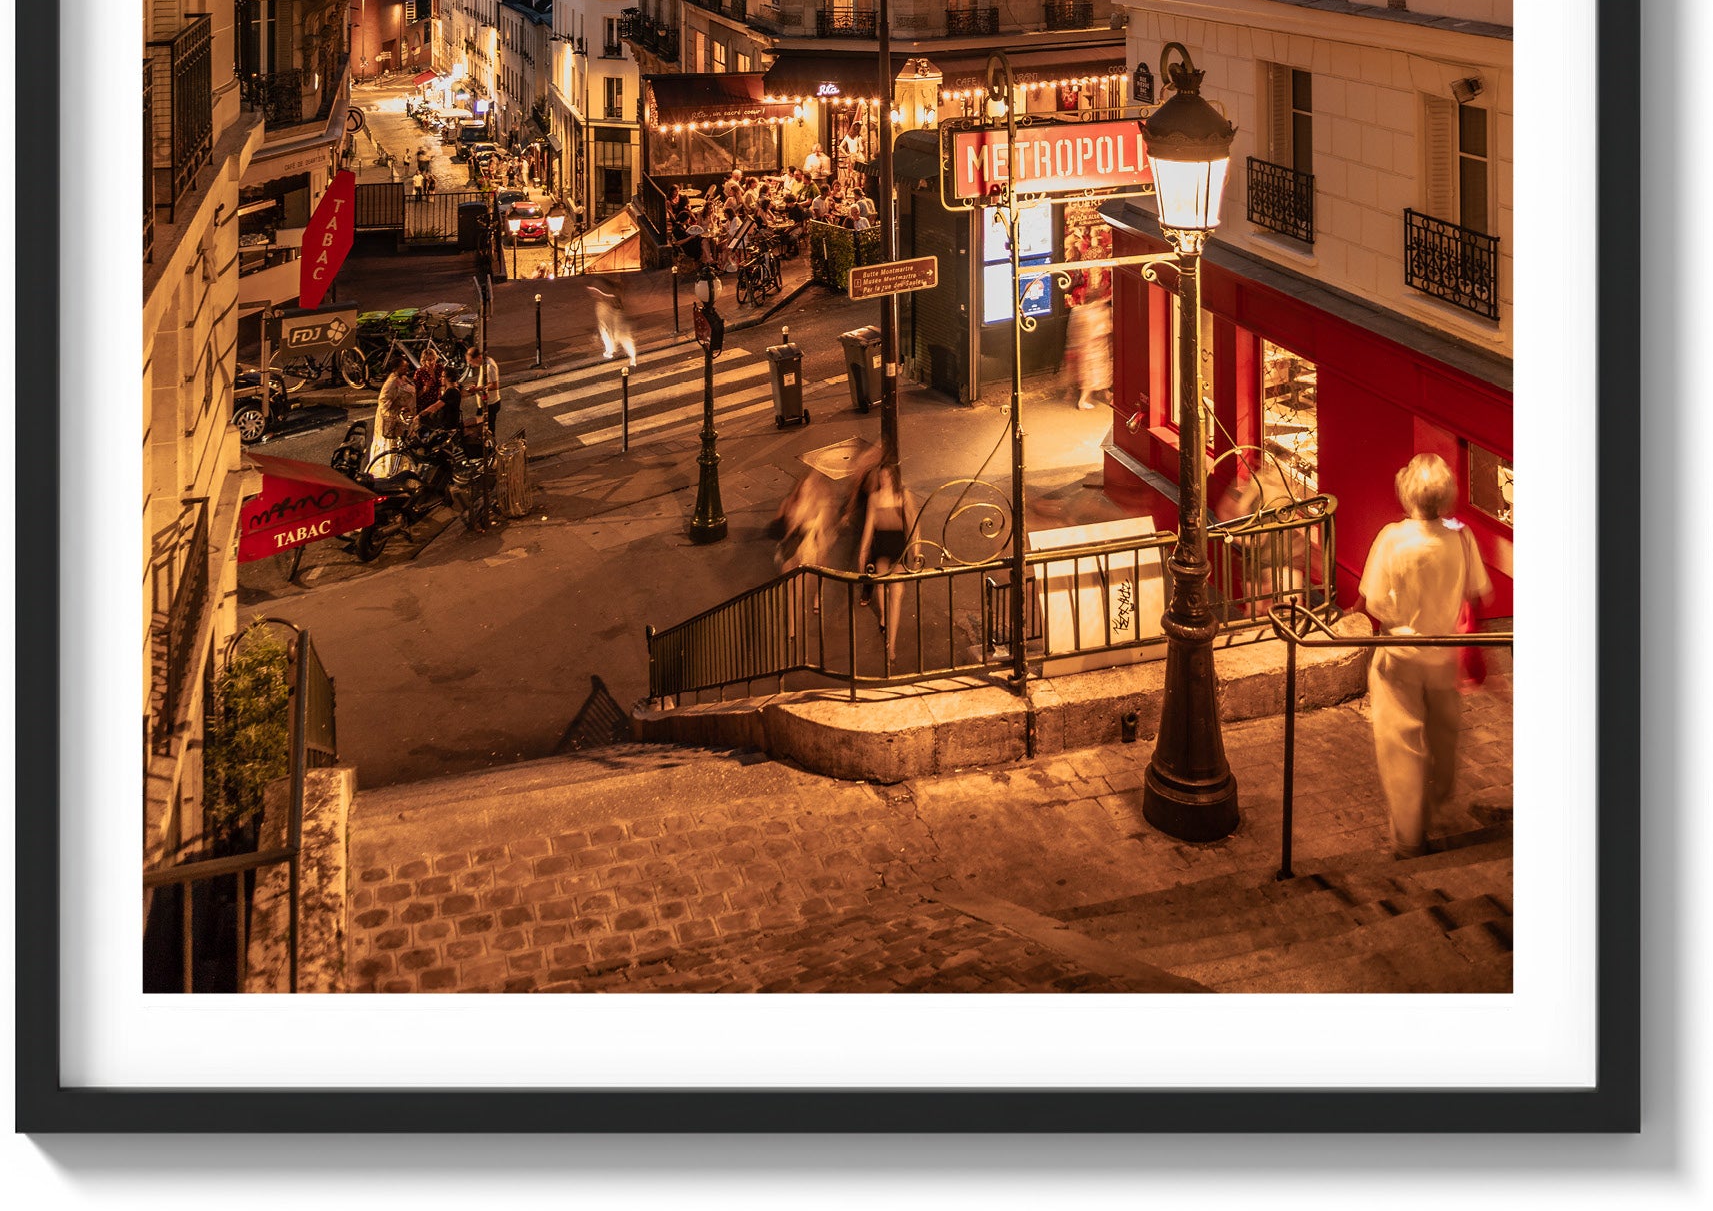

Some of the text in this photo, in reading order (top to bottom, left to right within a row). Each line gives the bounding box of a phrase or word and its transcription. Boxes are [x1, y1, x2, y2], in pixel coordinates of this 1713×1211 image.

[1013, 72, 1038, 83] URANT
[967, 133, 1144, 183] METROPOLI
[312, 198, 346, 280] TABAC
[862, 265, 914, 279] Butte Montmartre
[883, 273, 917, 282] Montmartre
[291, 326, 322, 344] FDJ
[273, 519, 331, 548] TABAC
